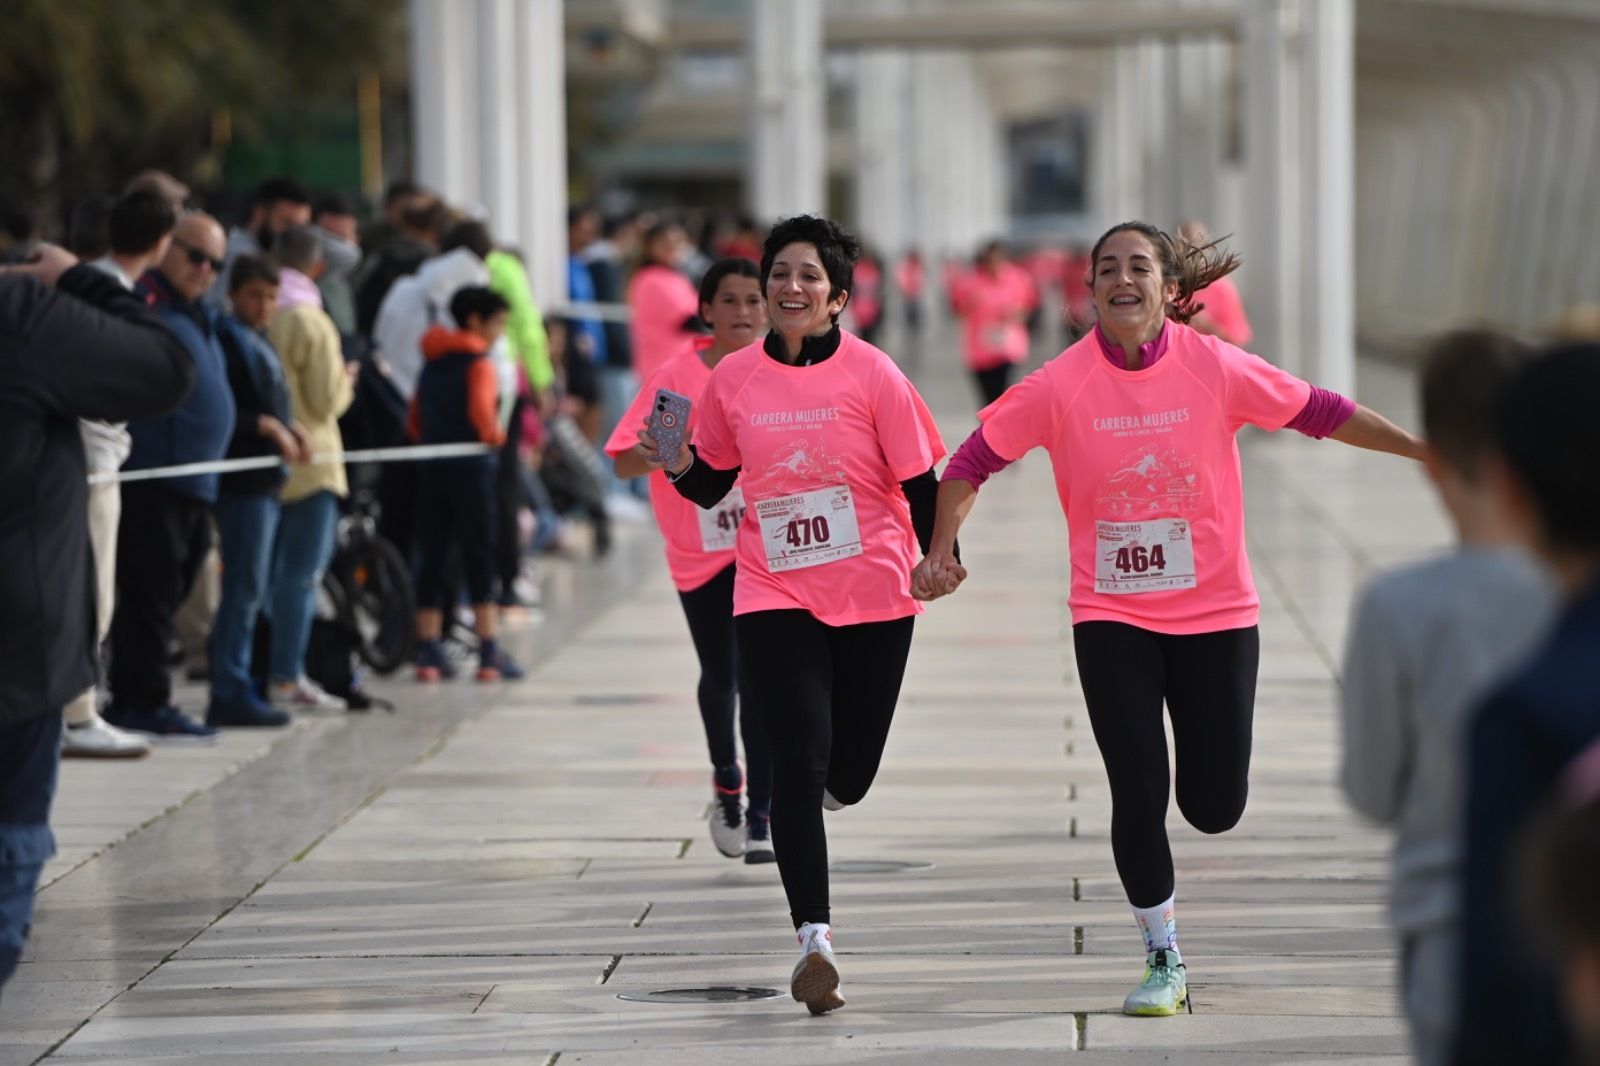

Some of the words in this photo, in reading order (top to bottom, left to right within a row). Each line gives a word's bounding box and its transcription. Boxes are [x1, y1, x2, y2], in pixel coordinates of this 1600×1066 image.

[751, 411, 793, 426] CARRERA
[795, 407, 840, 423] MUJERES
[1093, 416, 1140, 432] CARRERA
[1143, 408, 1190, 427] MUJERES
[718, 507, 747, 531] 41
[786, 515, 830, 547] 470
[1115, 544, 1166, 573] 464
